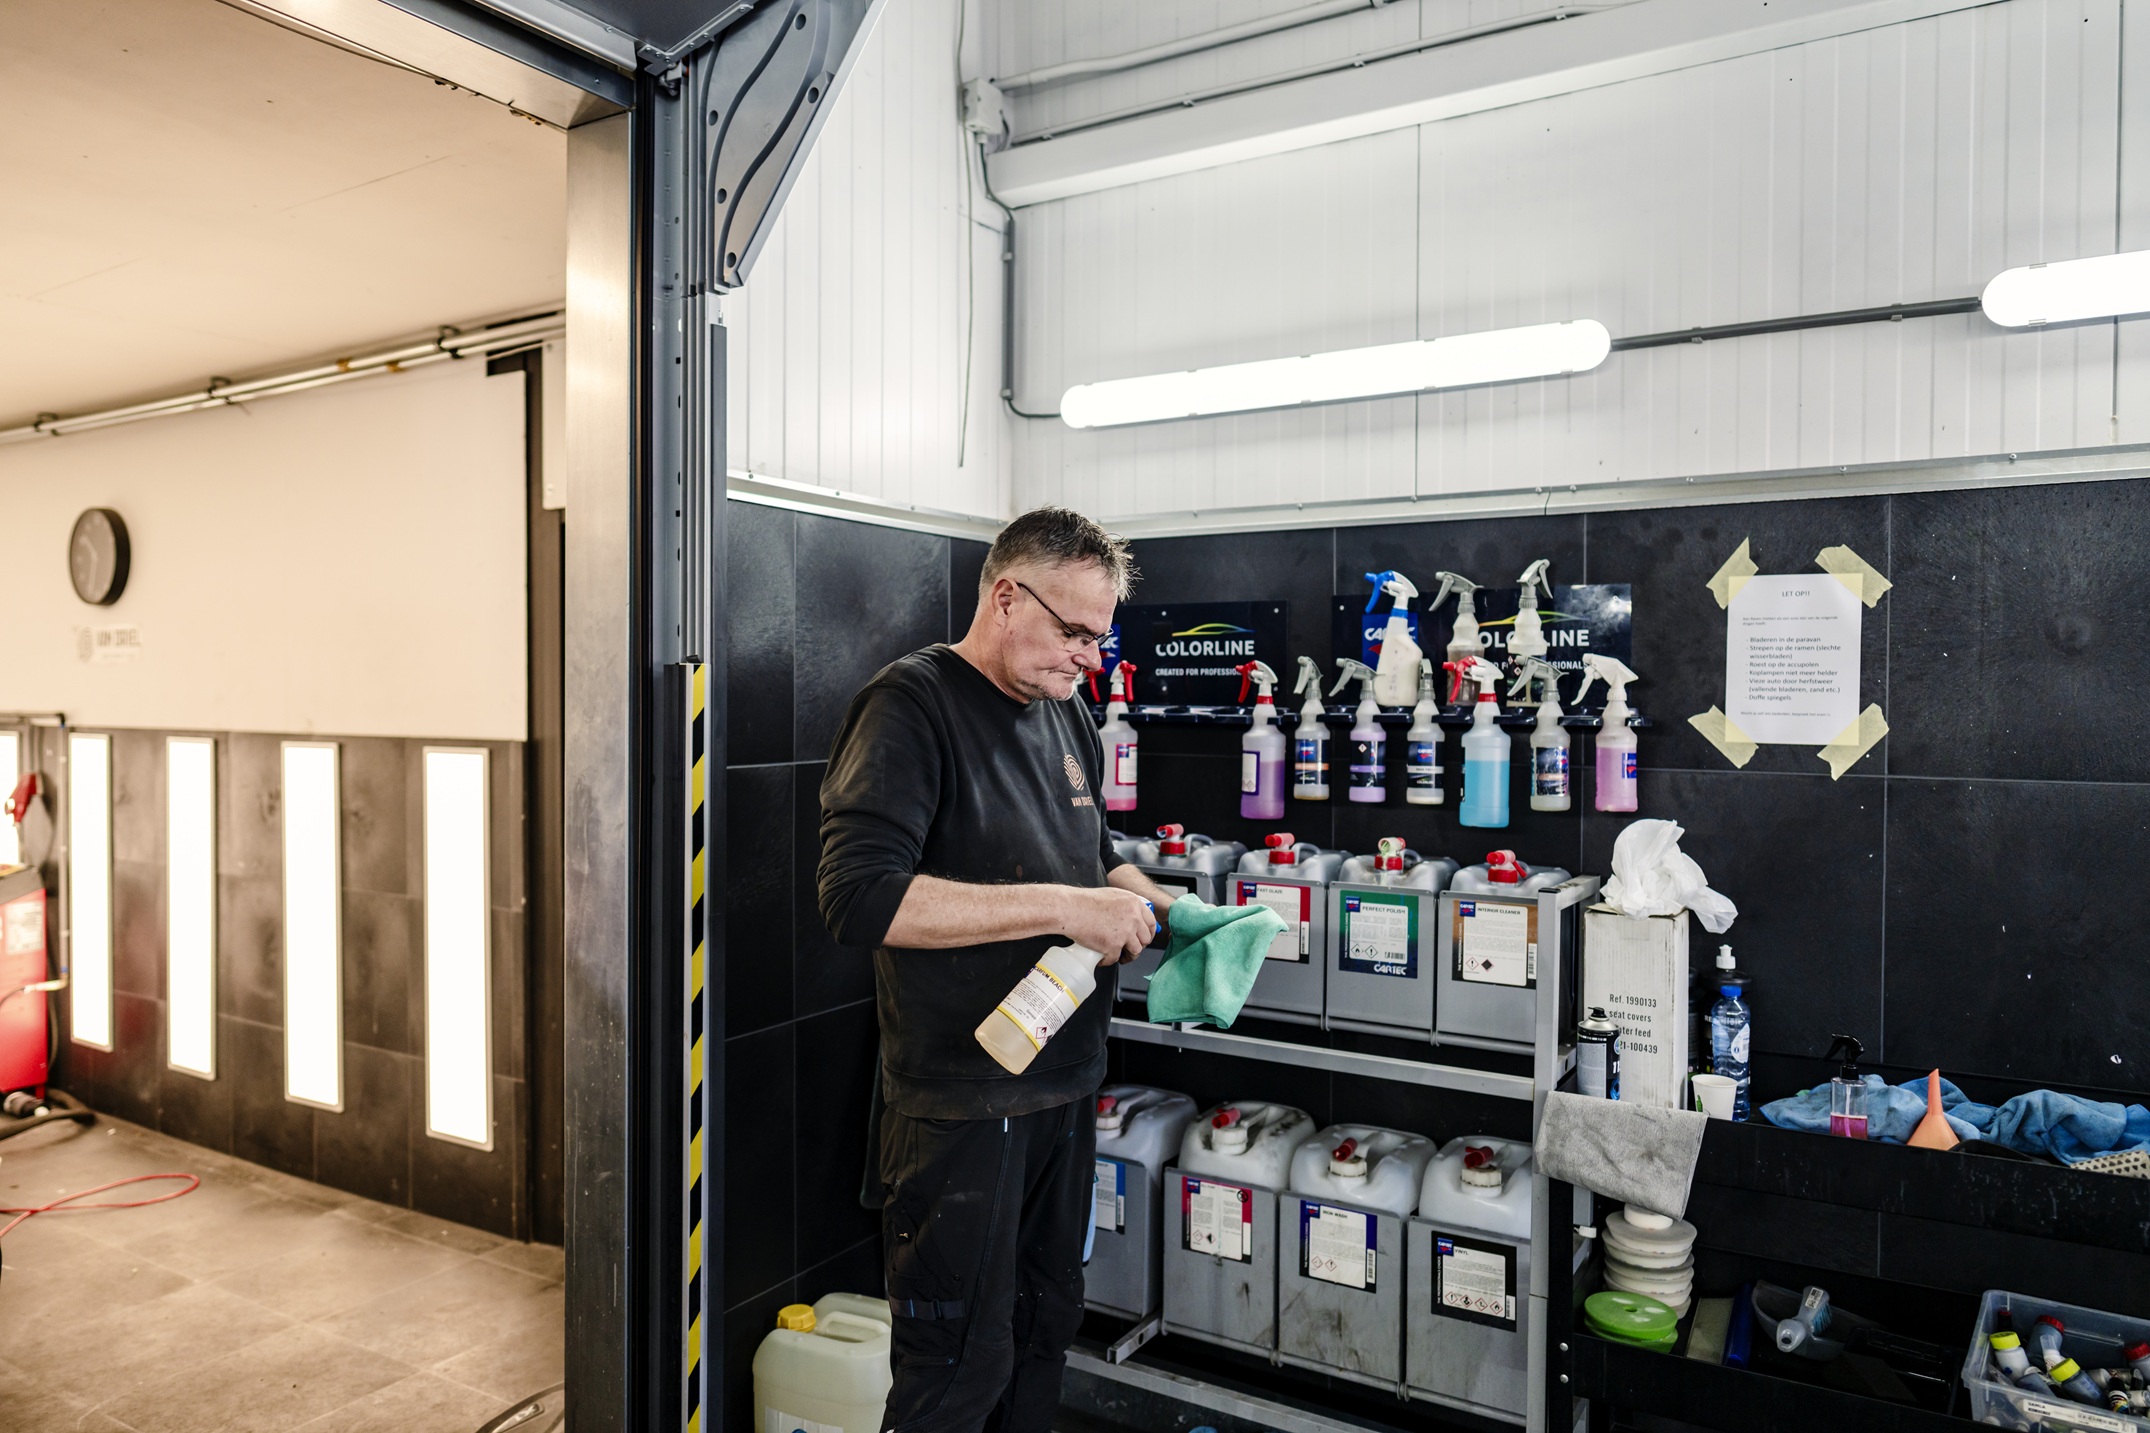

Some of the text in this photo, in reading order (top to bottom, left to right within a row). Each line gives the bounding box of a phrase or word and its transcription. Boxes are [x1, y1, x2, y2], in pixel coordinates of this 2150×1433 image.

[1477, 629, 1590, 648] OLLINE
[1155, 640, 1255, 656] COLORLINE
[1155, 668, 1184, 676] CREATED
[1374, 964, 1407, 975] CARTEC
[1609, 994, 1657, 1008] Ref. 1990133
[1609, 1010, 1652, 1022] seat covers
[1635, 1028, 1651, 1037] feed
[1620, 1041, 1658, 1054] 21-100439
